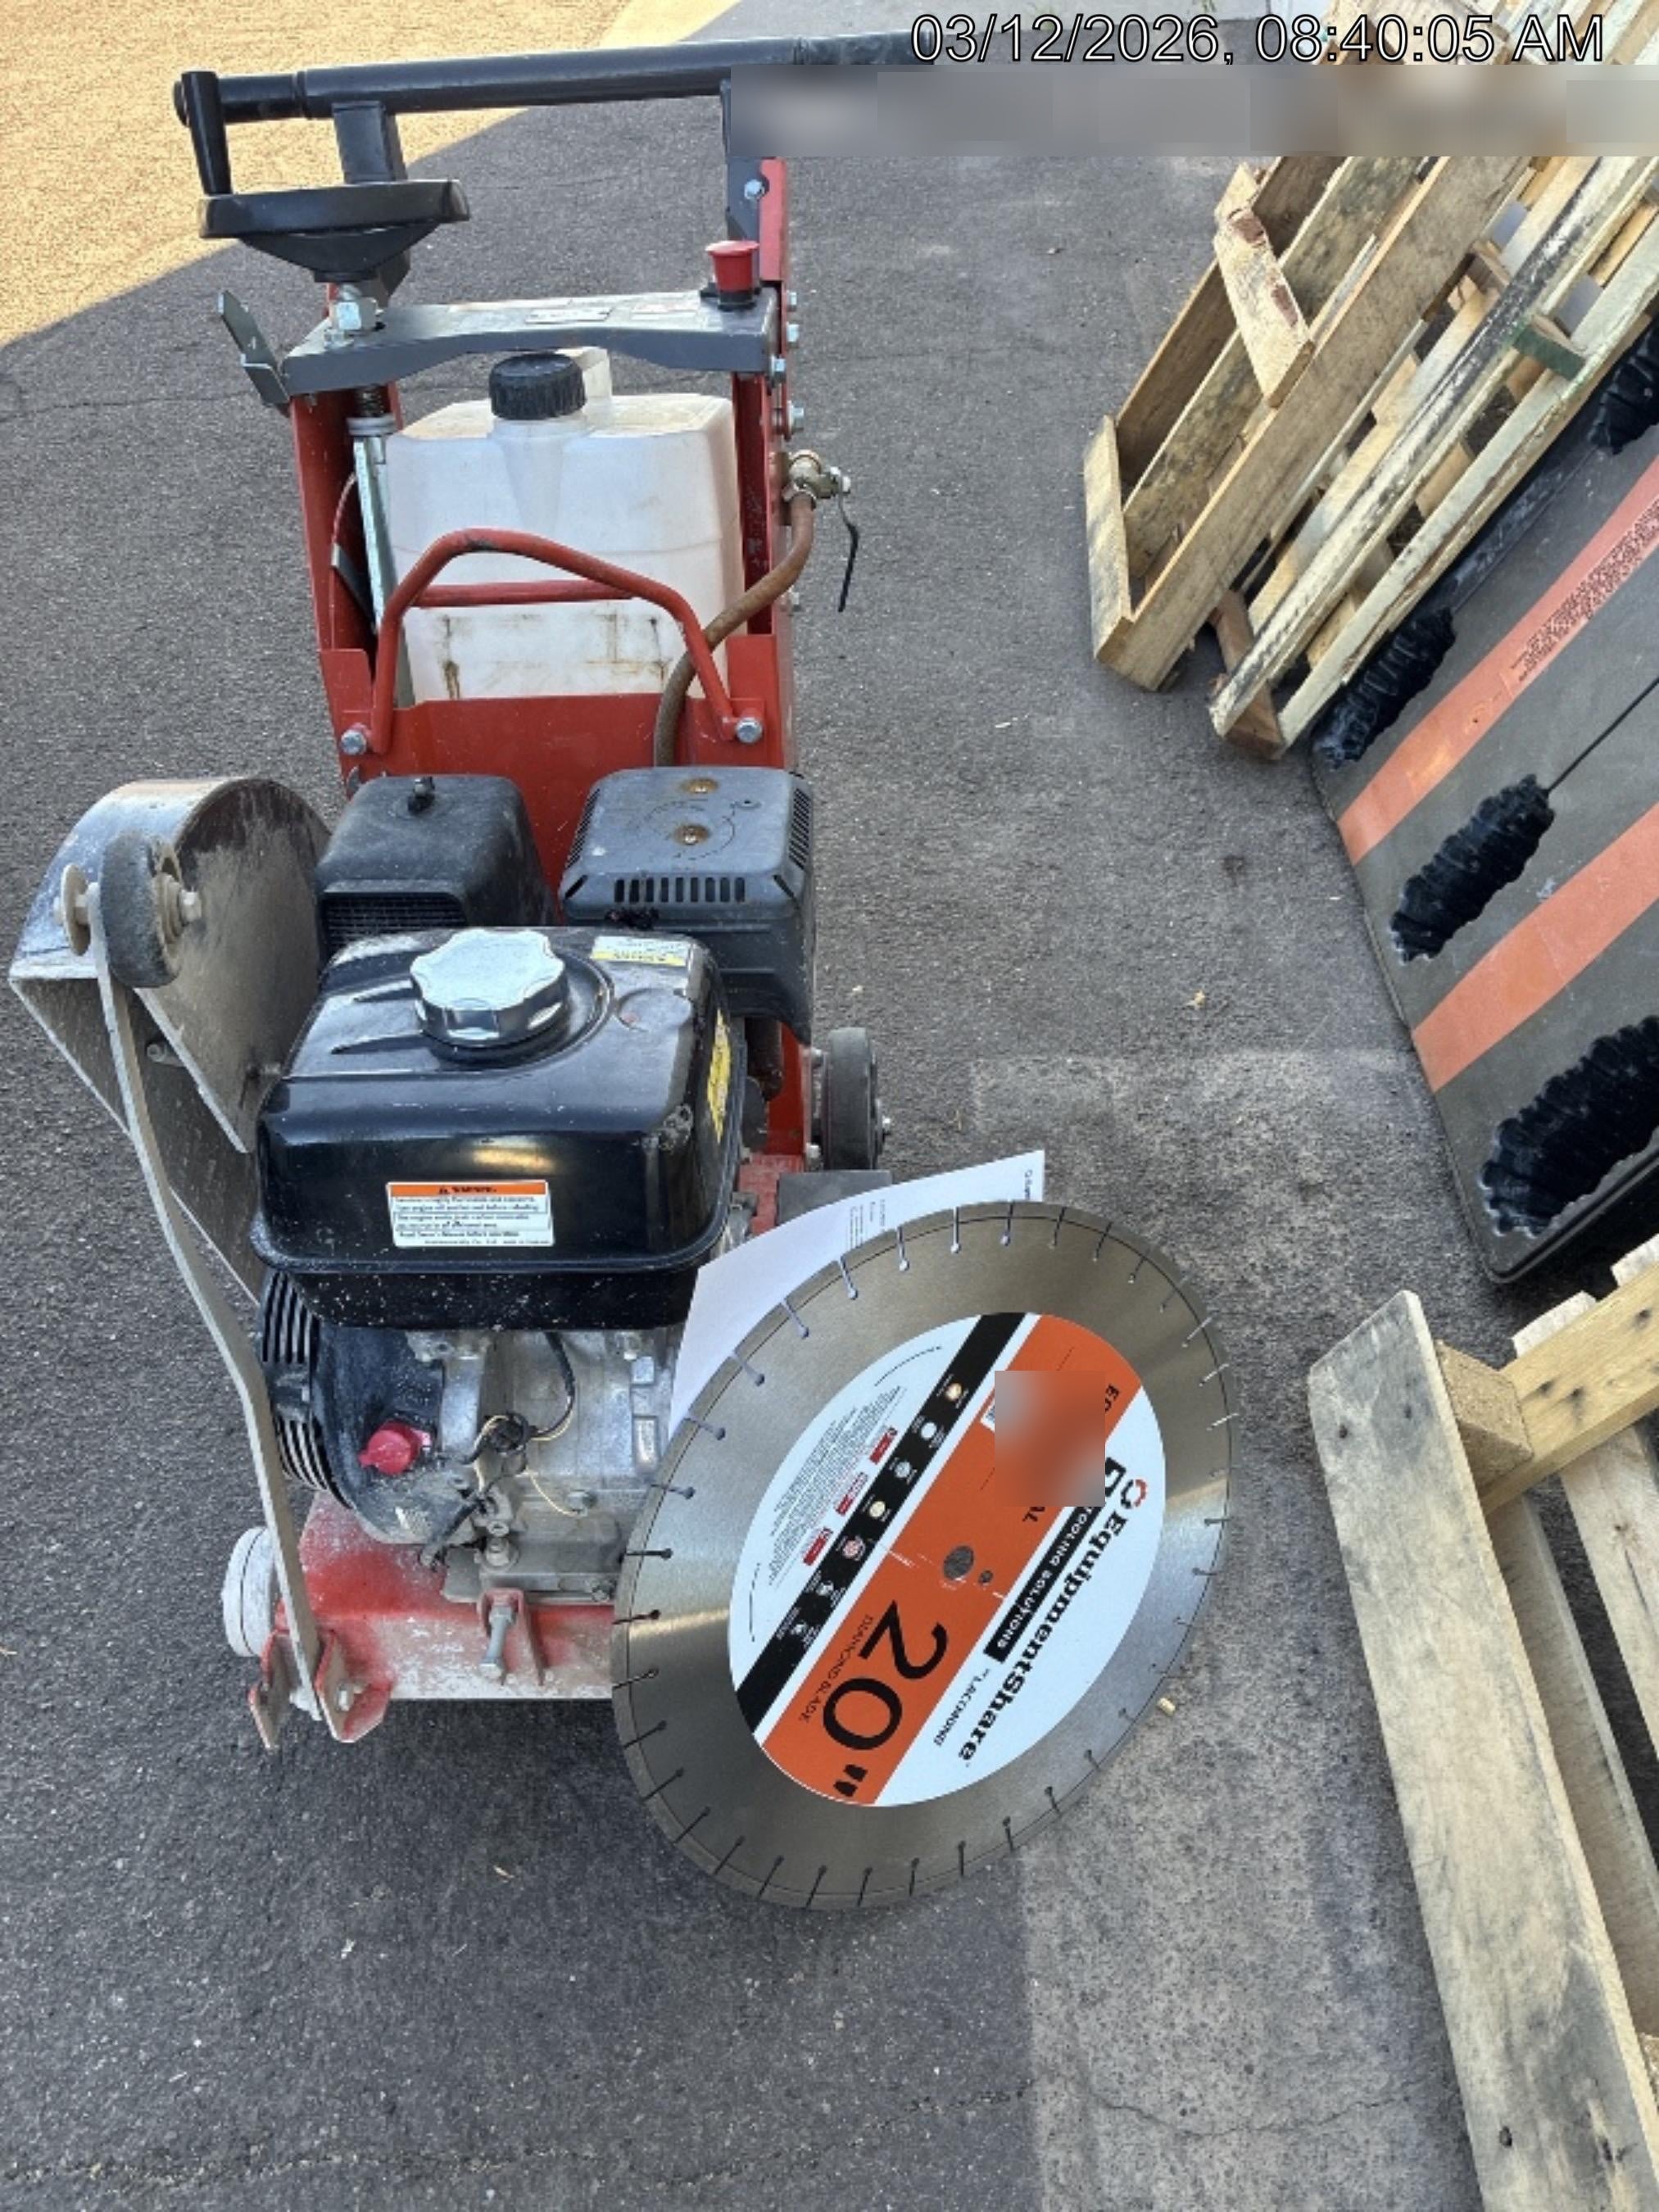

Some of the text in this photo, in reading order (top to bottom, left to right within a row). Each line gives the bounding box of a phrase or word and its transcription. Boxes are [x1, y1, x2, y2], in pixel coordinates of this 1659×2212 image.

[827, 1614, 874, 1679] DIAMOND
[958, 1509, 1129, 1760] EquipmentShare
[996, 1569, 1053, 1648] SOLUTIONS
[823, 1600, 948, 1797] 20"
